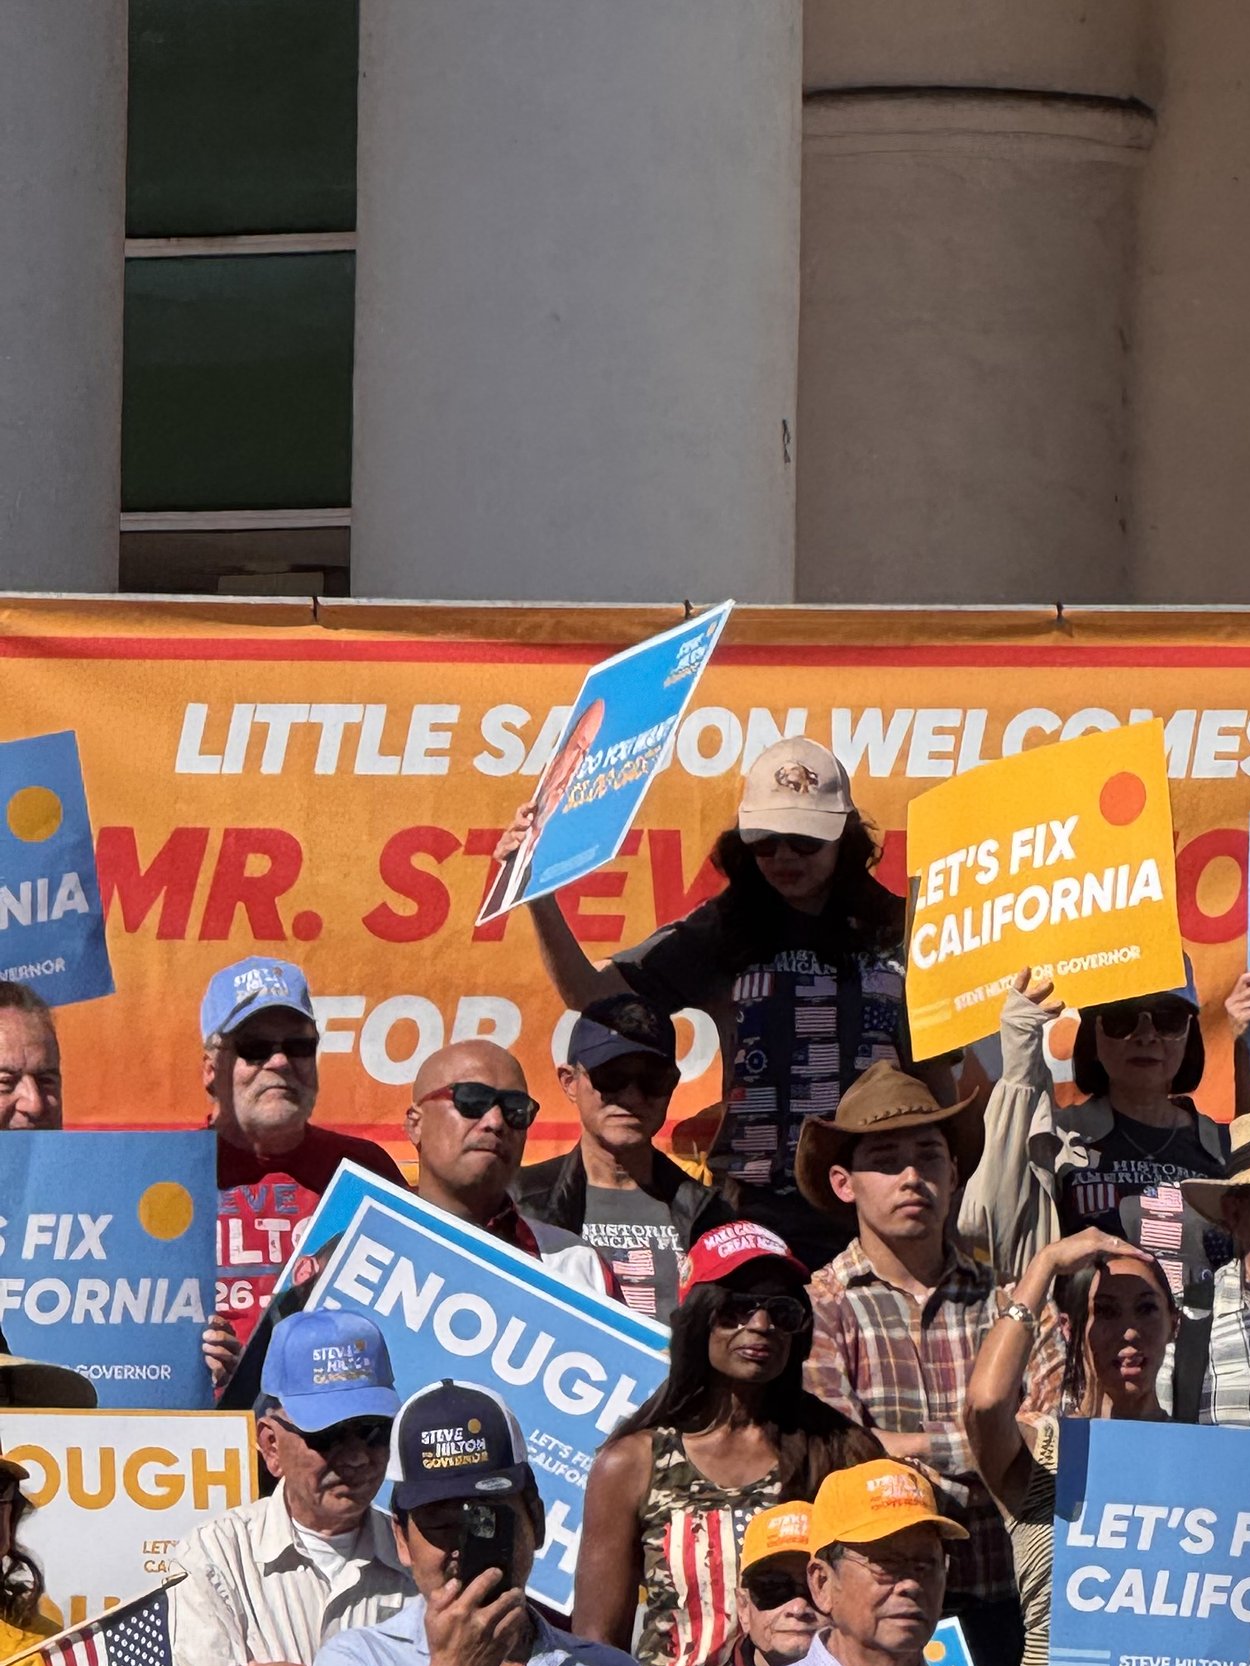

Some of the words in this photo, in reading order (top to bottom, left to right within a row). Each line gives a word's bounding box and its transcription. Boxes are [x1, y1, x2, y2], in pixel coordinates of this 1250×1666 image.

[175, 703, 461, 775] LITTLE
[1009, 815, 1079, 876] FIX
[95, 825, 323, 943] MR.
[911, 858, 1164, 969] CALIFORNIA
[22, 1213, 113, 1260] FIX
[1066, 1503, 1218, 1555] LET'S
